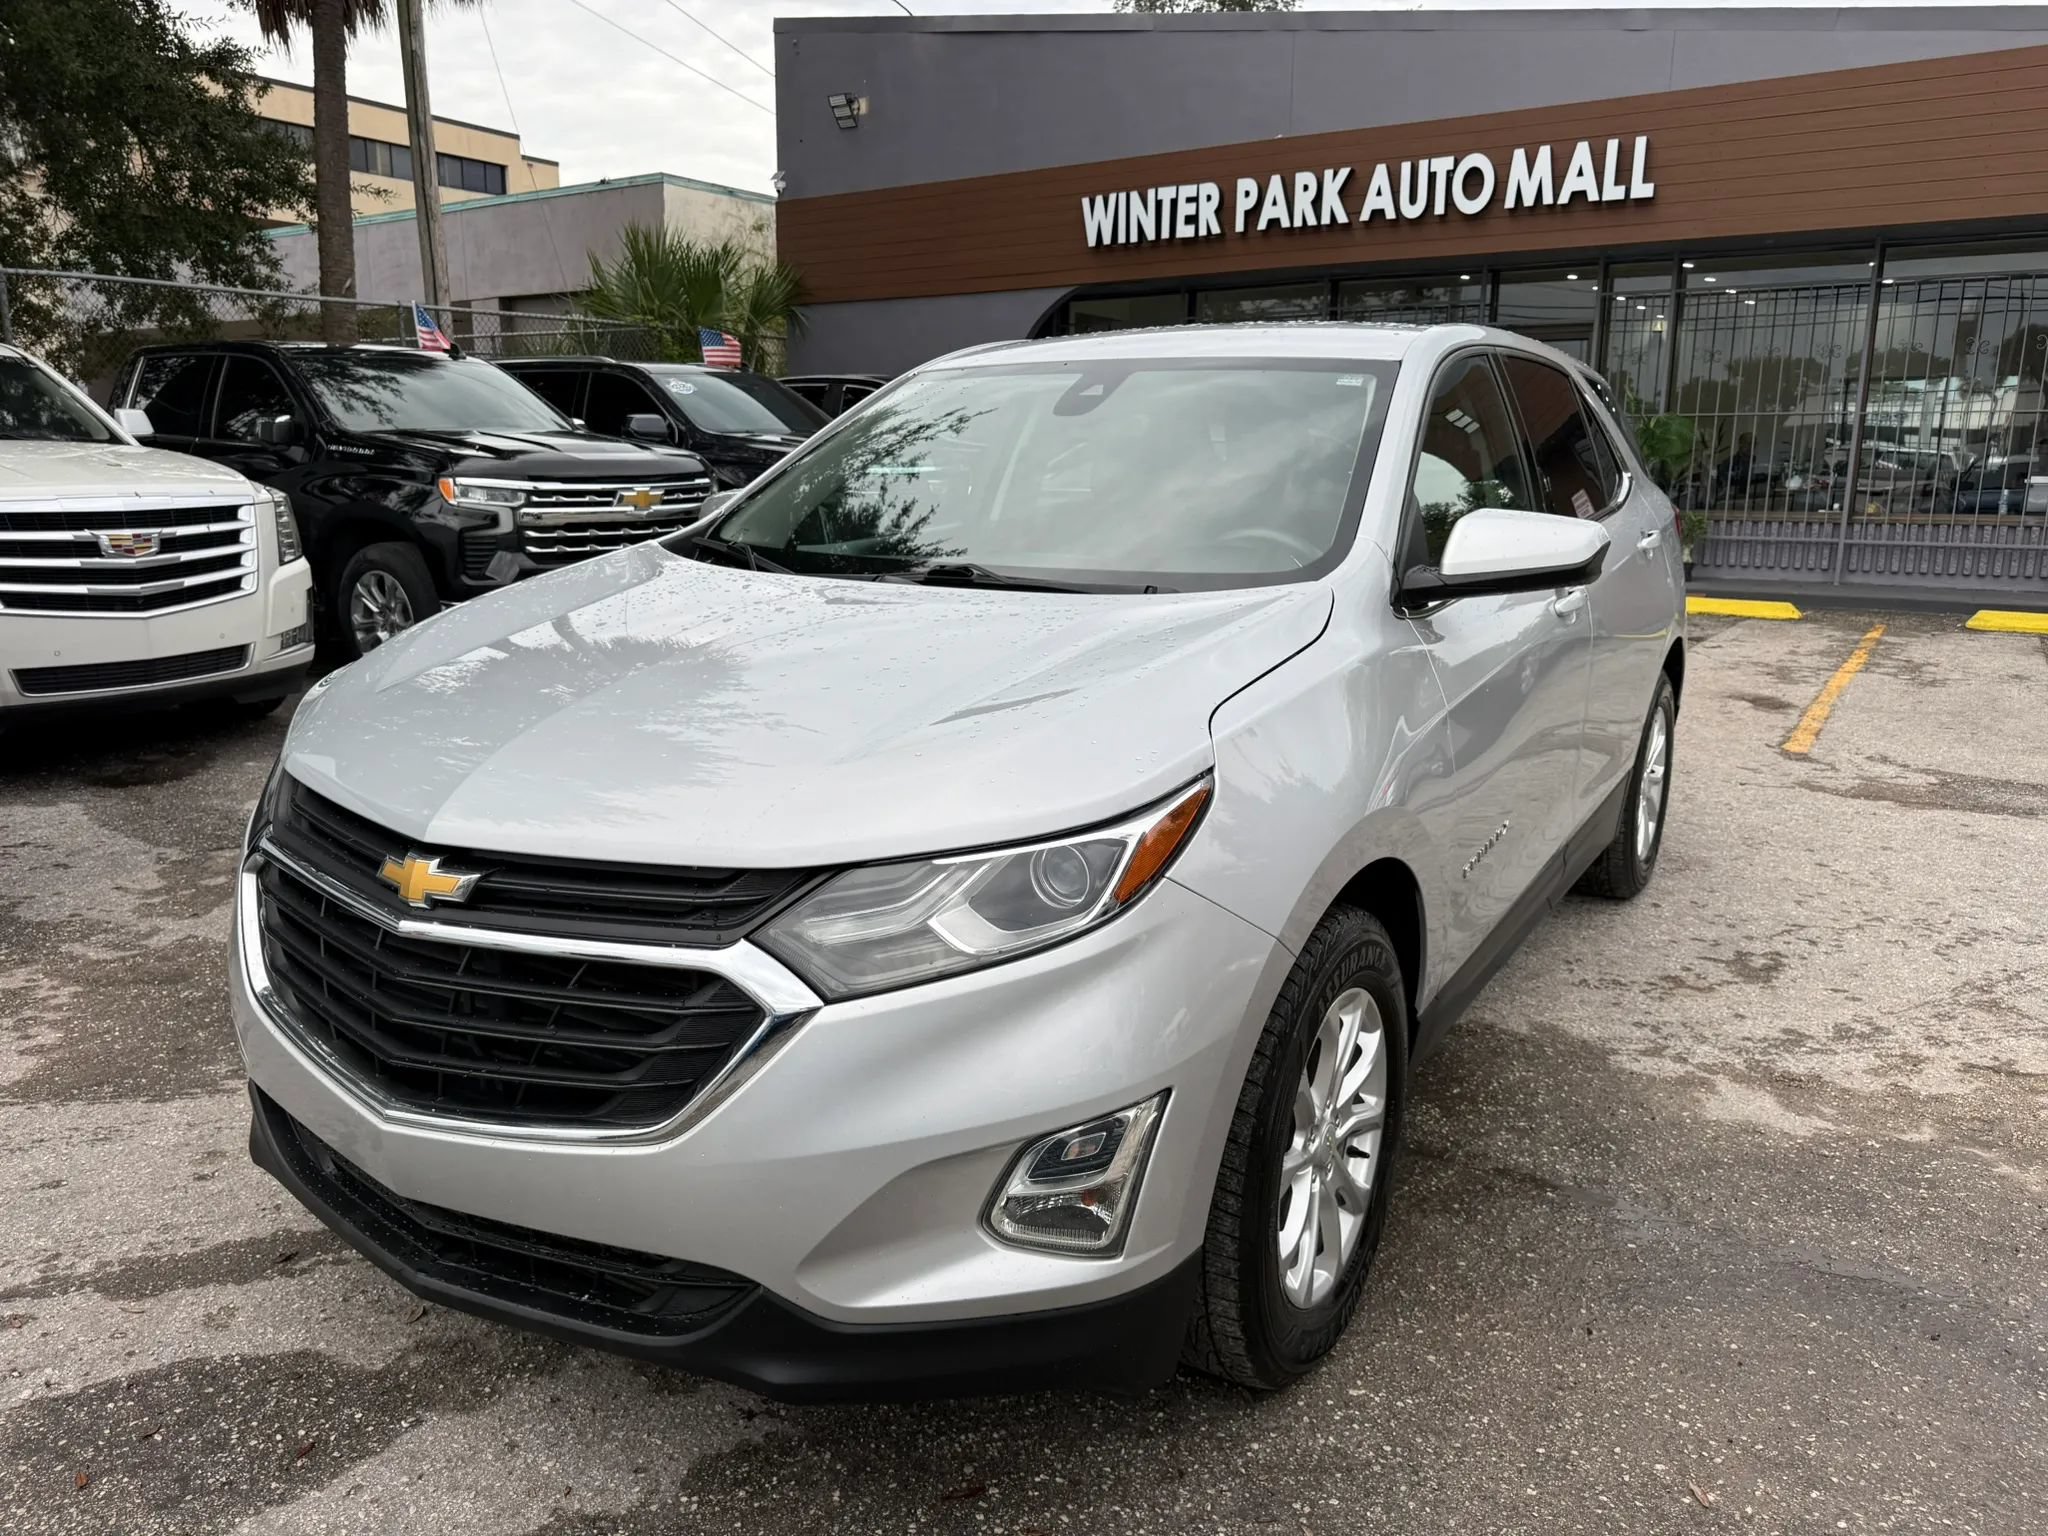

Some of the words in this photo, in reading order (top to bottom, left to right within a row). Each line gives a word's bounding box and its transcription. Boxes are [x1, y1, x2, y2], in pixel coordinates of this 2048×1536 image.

[1081, 182, 1221, 247] WINTER
[1234, 166, 1352, 233] PARK
[1358, 152, 1495, 222] AUTO
[1503, 135, 1655, 209] MALL
